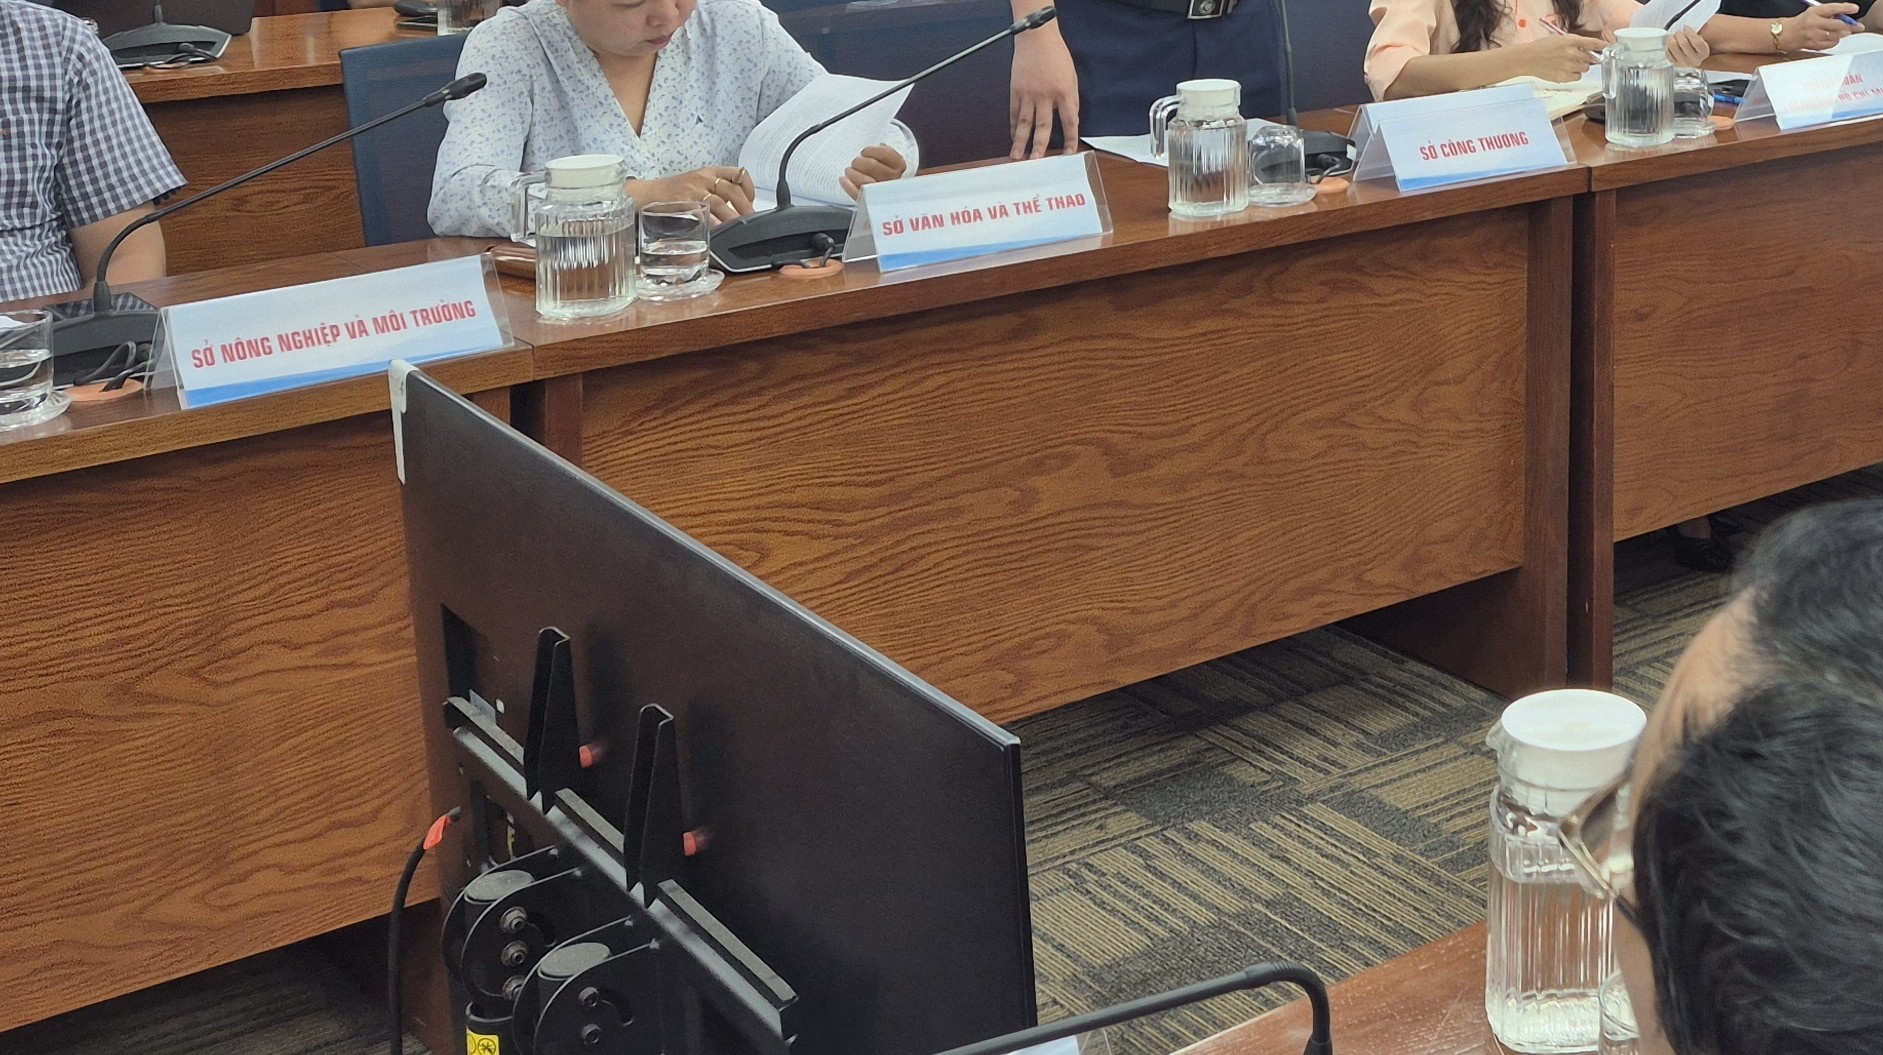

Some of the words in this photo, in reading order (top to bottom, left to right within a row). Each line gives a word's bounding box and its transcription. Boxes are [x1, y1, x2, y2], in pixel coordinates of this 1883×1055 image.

[1419, 140, 1438, 161] SỞ
[1440, 138, 1477, 158] CÔNG
[1478, 131, 1529, 152] THƯƠNG
[882, 215, 904, 236] SỞ
[909, 213, 945, 233] VĂN
[951, 206, 984, 226] HÓA
[987, 202, 1010, 220] VÀ
[1012, 194, 1042, 216] THỂ
[1046, 193, 1087, 211] THAO
[191, 339, 215, 369] SỞ
[221, 337, 272, 364] NÔNG
[277, 322, 341, 353] NGHIỆP
[344, 314, 368, 340] VÀ
[372, 310, 408, 335] MÔI
[409, 299, 477, 328] TRƯỜNG
